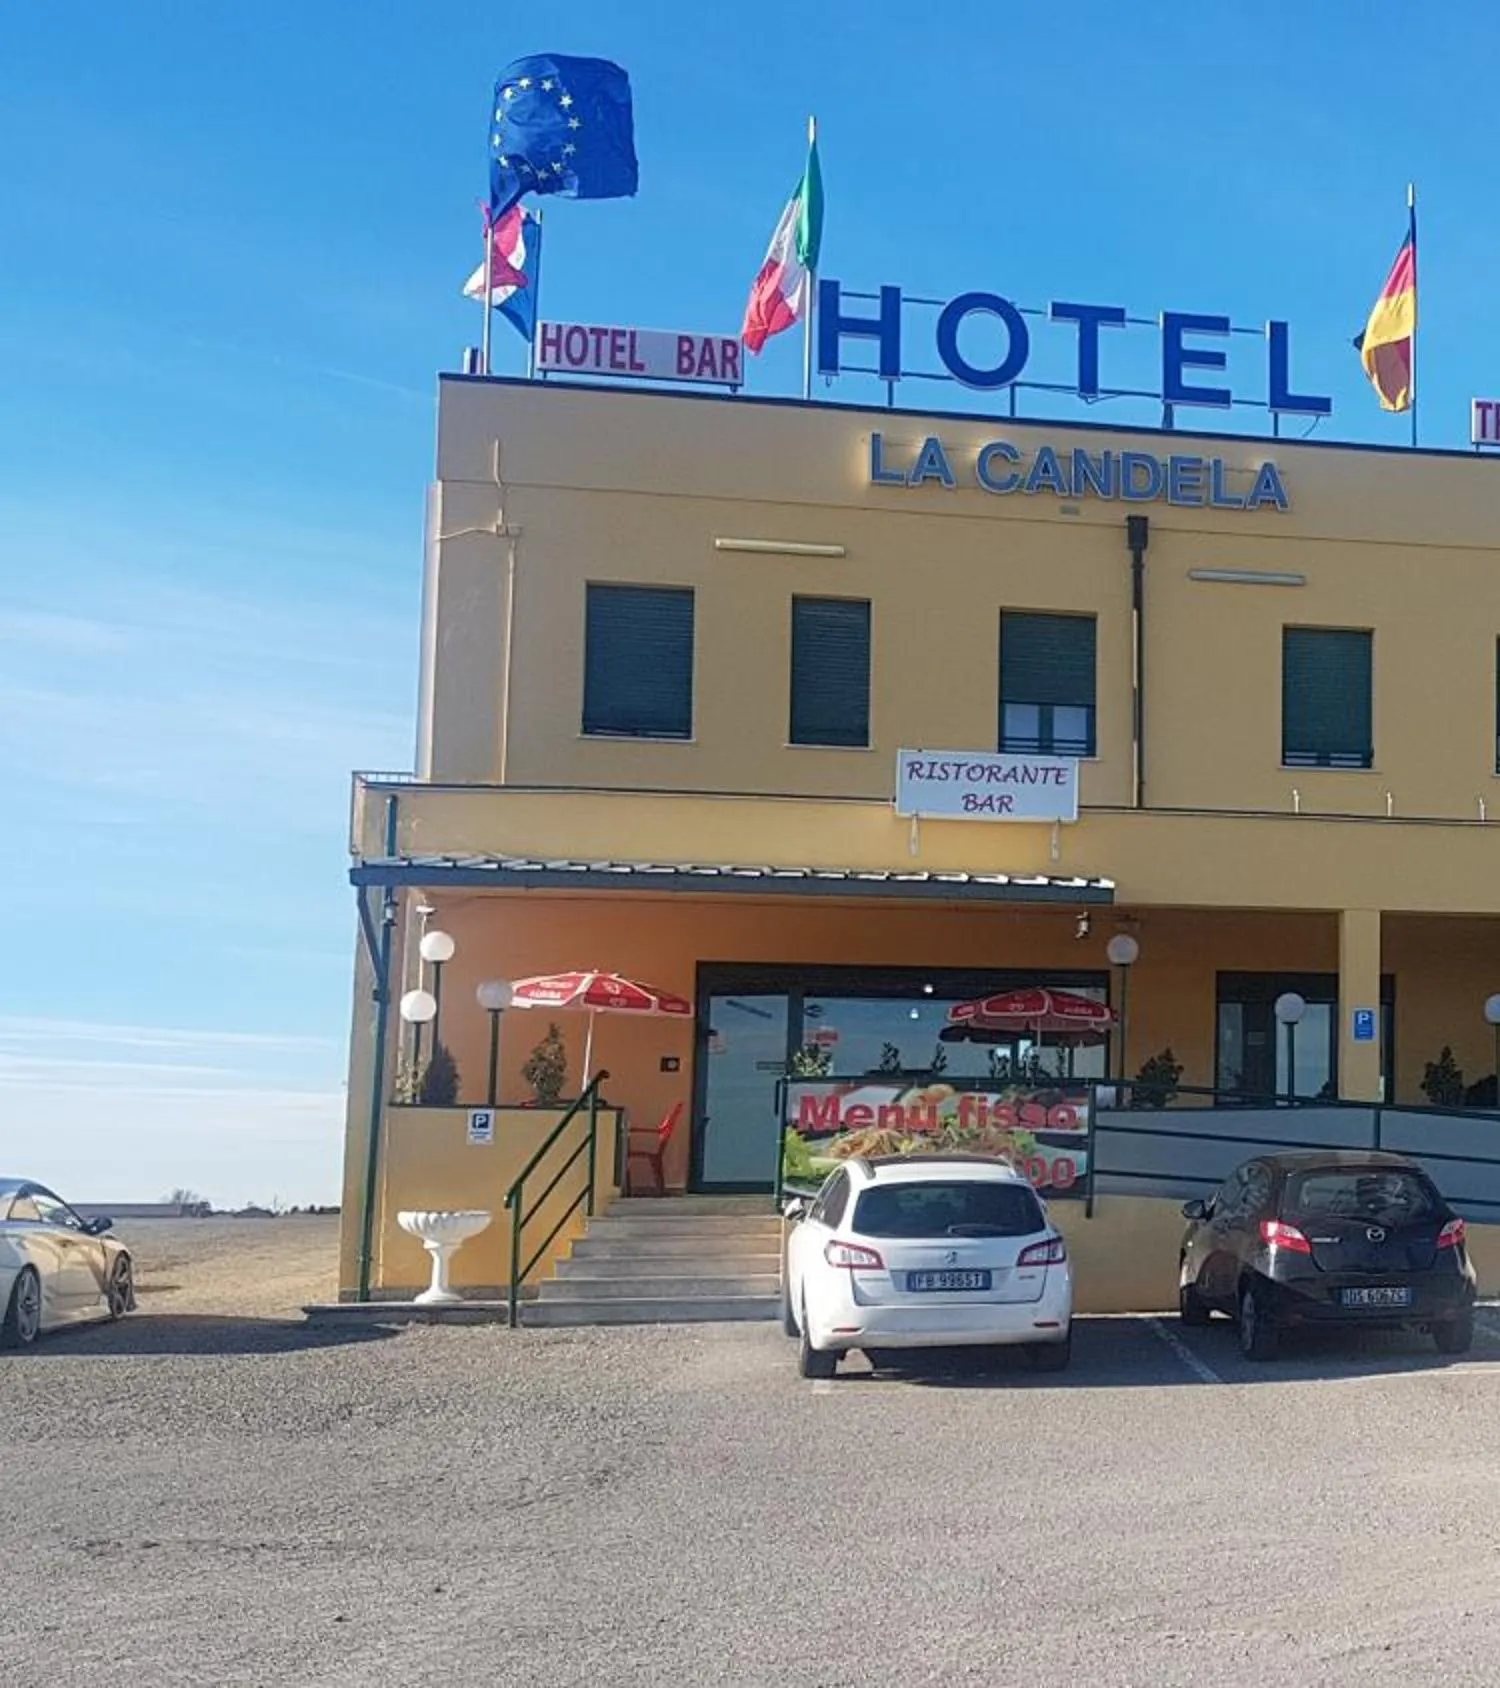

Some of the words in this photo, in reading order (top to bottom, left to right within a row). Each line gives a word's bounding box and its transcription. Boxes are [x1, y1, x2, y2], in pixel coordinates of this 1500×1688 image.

[540, 323, 645, 372] HOTEL
[676, 335, 740, 380] BAR
[818, 279, 1332, 415] HOTEL
[870, 431, 956, 488] LA
[974, 438, 1290, 511] CANDELA
[906, 760, 1069, 786] RISTORANTE
[961, 793, 1014, 813] BAR
[957, 1095, 1078, 1130] fisso
[1014, 1152, 1076, 1189] 00
